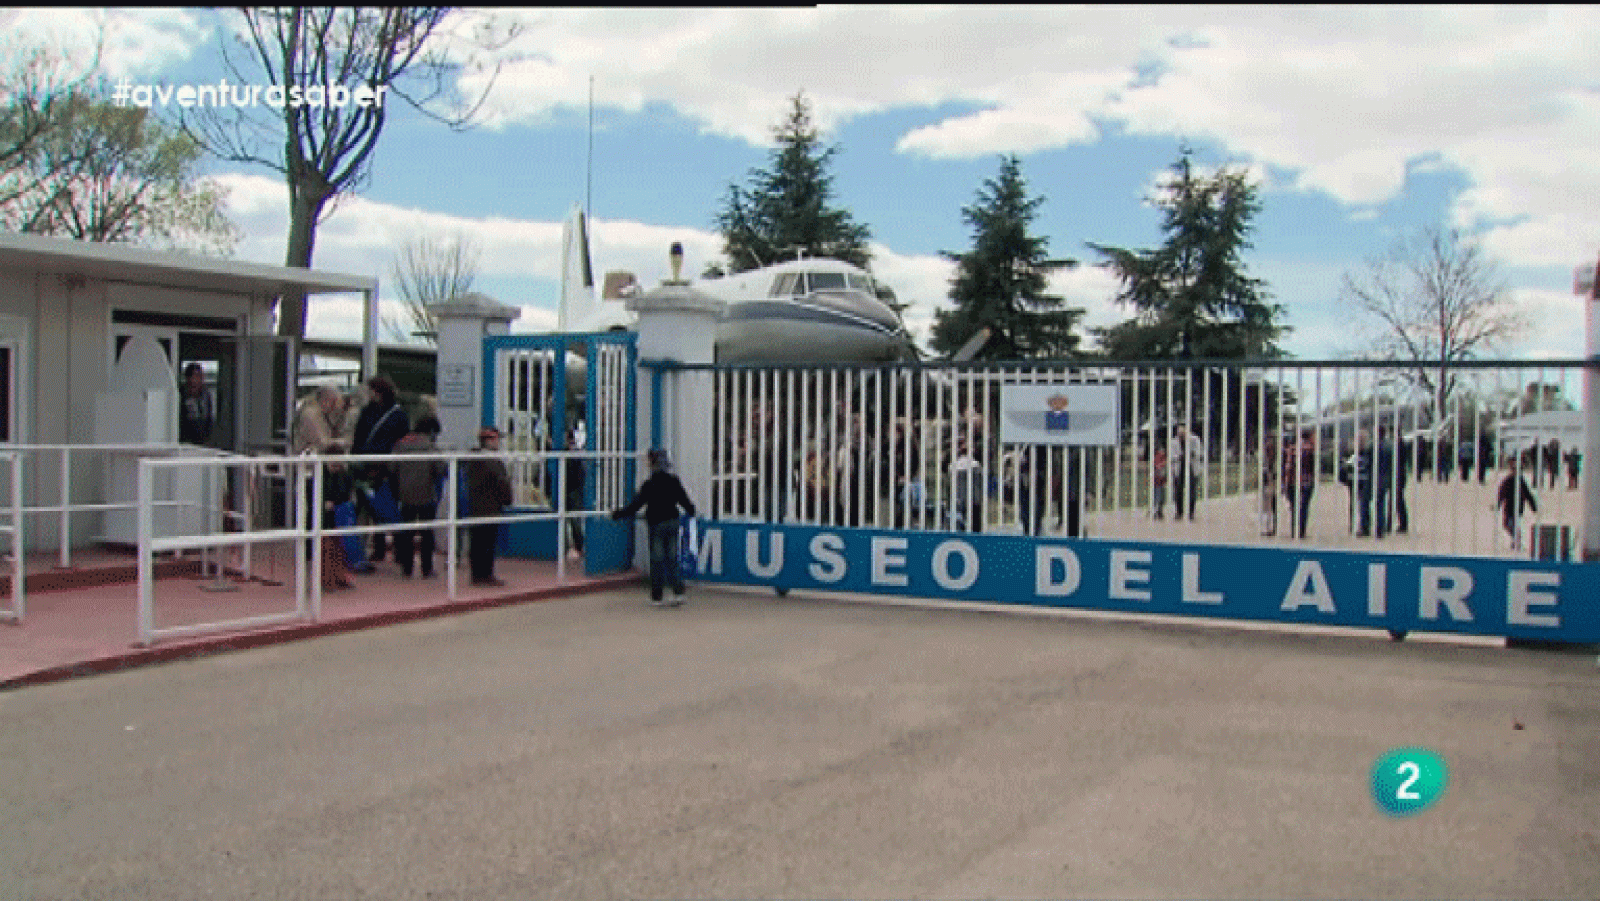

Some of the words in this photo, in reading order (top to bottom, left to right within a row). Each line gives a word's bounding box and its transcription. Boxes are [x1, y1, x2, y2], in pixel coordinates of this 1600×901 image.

[696, 529, 980, 590] MUSEO
[1035, 546, 1224, 604] DEL
[1280, 560, 1562, 627] AIRE
